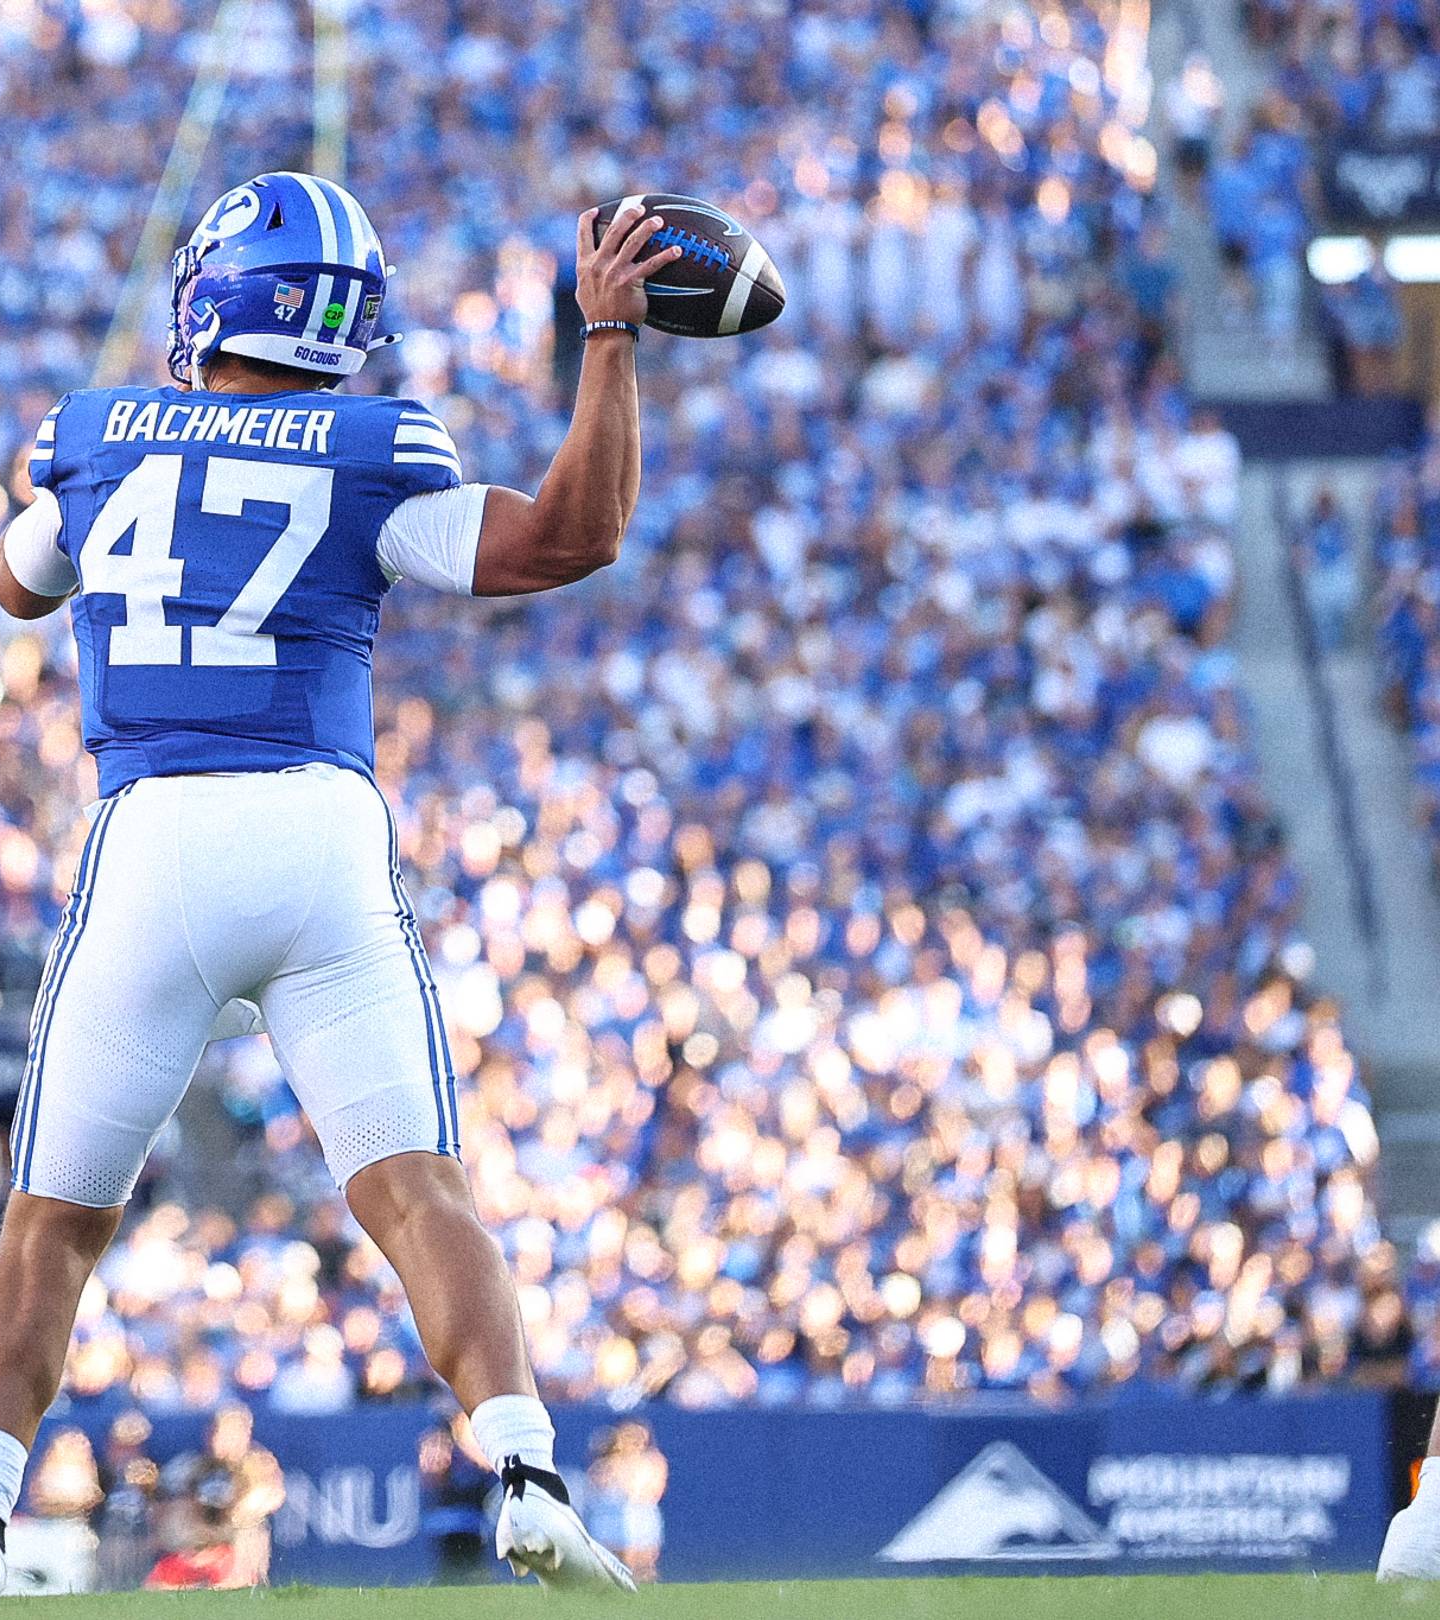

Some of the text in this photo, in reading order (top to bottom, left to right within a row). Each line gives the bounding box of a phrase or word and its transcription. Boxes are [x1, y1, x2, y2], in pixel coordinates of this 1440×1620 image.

[274, 305, 296, 322] 47
[324, 310, 343, 321] C2P
[294, 346, 342, 366] GO COUGS
[103, 400, 336, 454] BACHMEIER
[79, 454, 335, 666] 47
